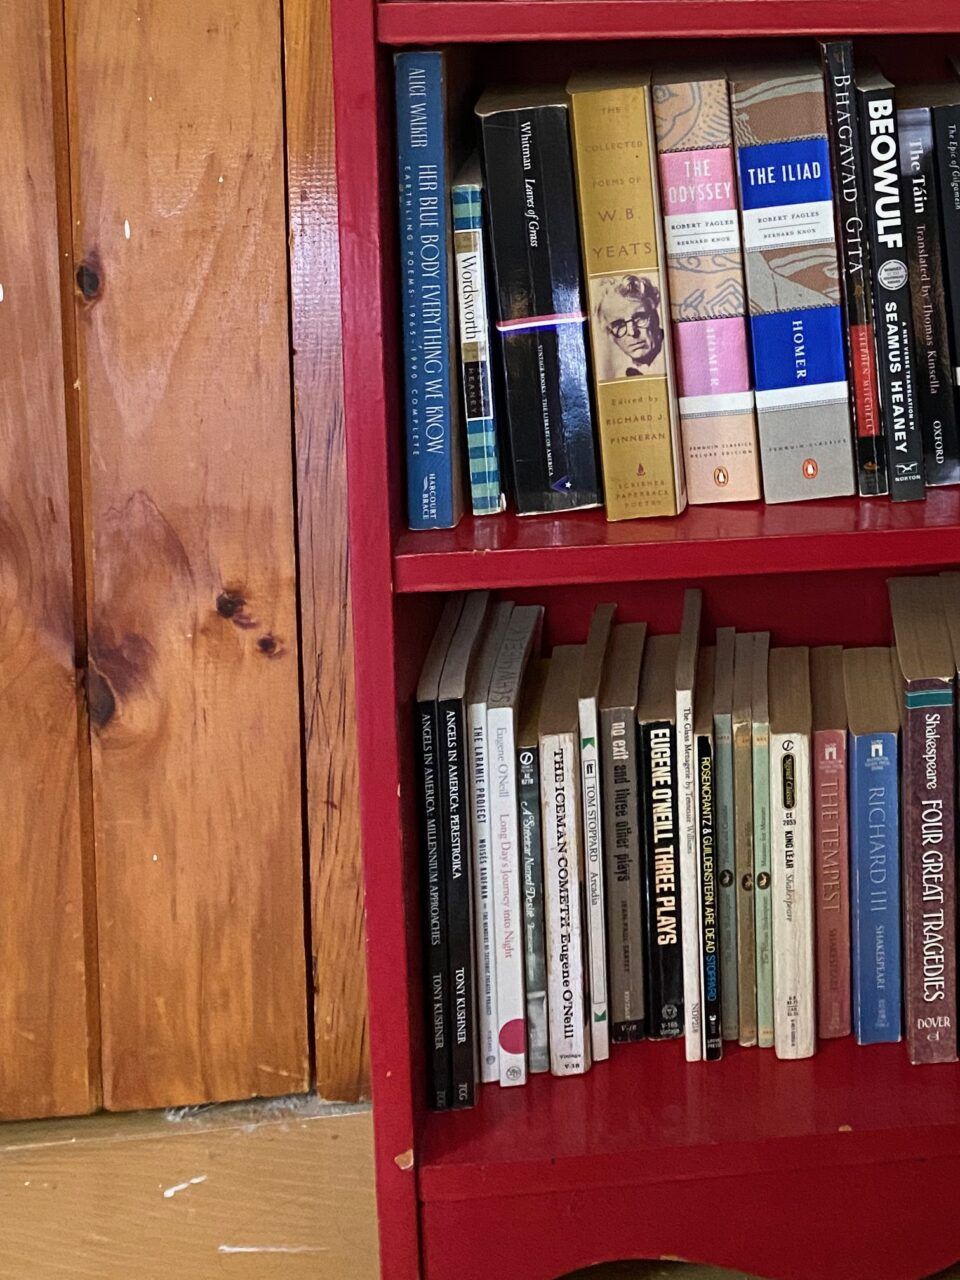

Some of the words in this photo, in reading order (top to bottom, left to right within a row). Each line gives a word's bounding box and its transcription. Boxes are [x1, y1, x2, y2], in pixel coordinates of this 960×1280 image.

[406, 67, 426, 99] ALICE
[409, 103, 429, 148] WALKER
[521, 121, 532, 171] Whitman
[833, 74, 859, 202] BHAGAVAD
[419, 164, 438, 198] HER
[668, 181, 732, 205] ODYSSEY
[684, 158, 711, 178] THE
[747, 166, 776, 187] THE
[780, 161, 822, 181] ILIAD
[867, 98, 904, 256] BEOWULF
[420, 201, 440, 231] BLUE
[420, 233, 441, 282] BODY
[592, 242, 653, 260] YEATS
[844, 215, 865, 274] GITA
[460, 255, 478, 340] Wordsworth
[421, 284, 444, 376] EVERYTHING
[791, 319, 809, 380] HOMER
[885, 300, 901, 374] SEAMUS
[425, 378, 443, 403] WE
[425, 406, 444, 455] KNOW
[890, 379, 909, 455] HEANEY
[553, 748, 565, 783] THE
[649, 727, 671, 787] EUGENE
[922, 713, 941, 791] Shakespeare
[554, 786, 568, 853] ICEMAN
[651, 788, 675, 844] O'NEILL
[868, 786, 888, 884] RICHARD
[921, 799, 943, 847] FOUR
[654, 845, 677, 894] THREE
[922, 850, 944, 904] GREAT
[655, 896, 679, 946] PLAYS
[871, 889, 889, 912] III
[456, 967, 466, 994] TONY
[561, 932, 572, 987] Eugene
[923, 908, 946, 1003] TRAGEDIES
[457, 996, 467, 1046] KUSHNER
[563, 989, 575, 1041] O'Neill
[917, 1016, 952, 1029] DOVER
